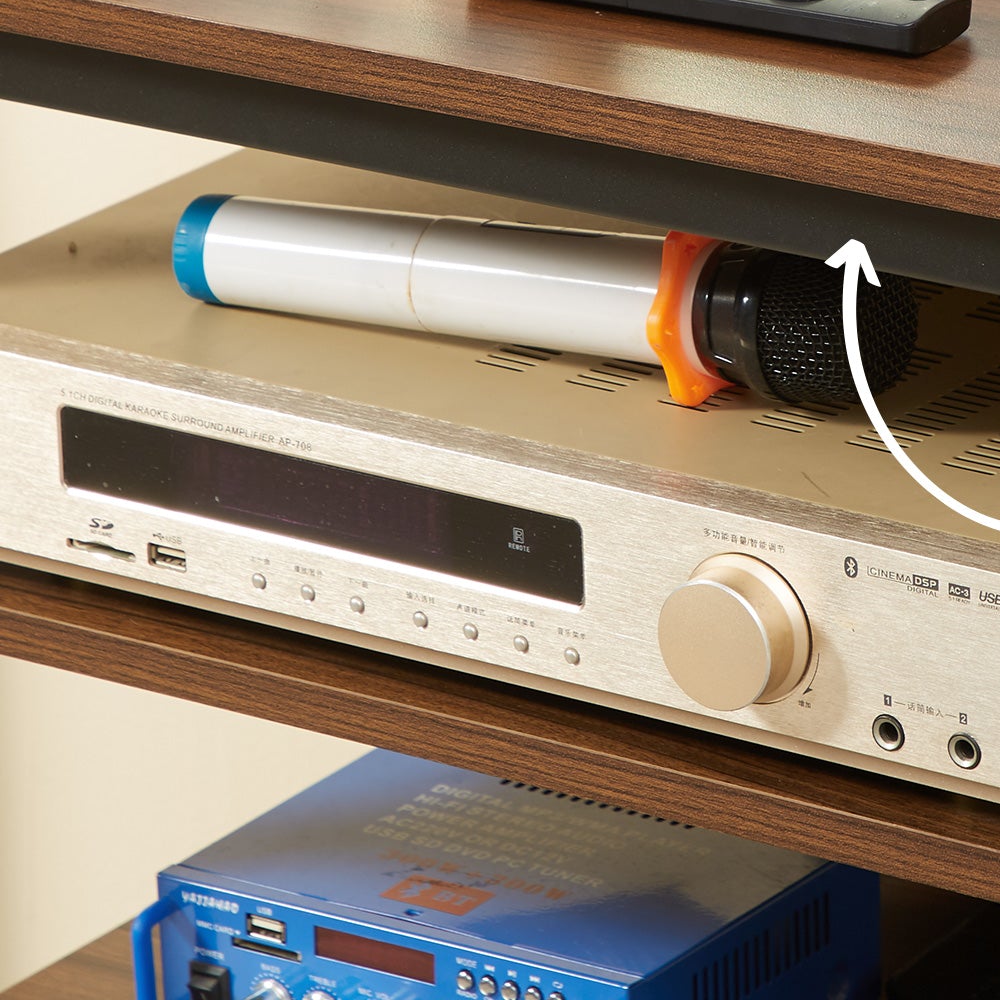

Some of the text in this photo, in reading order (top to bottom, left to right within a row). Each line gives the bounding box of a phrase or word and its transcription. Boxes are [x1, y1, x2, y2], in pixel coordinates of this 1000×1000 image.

[88, 394, 122, 410] DIGITAL
[125, 401, 169, 421] KARAOKE
[170, 412, 224, 432] SURROUND
[225, 425, 275, 443] AMPLIFIER
[907, 585, 939, 599] DIGITAL
[948, 582, 970, 600] AC-3
[884, 694, 893, 707] 1
[959, 712, 968, 725] 2
[430, 784, 513, 810] DIGITAL
[396, 804, 479, 830] POWER
[362, 823, 606, 889] USB SD DVD PC TUNER
[431, 889, 474, 907] BT
